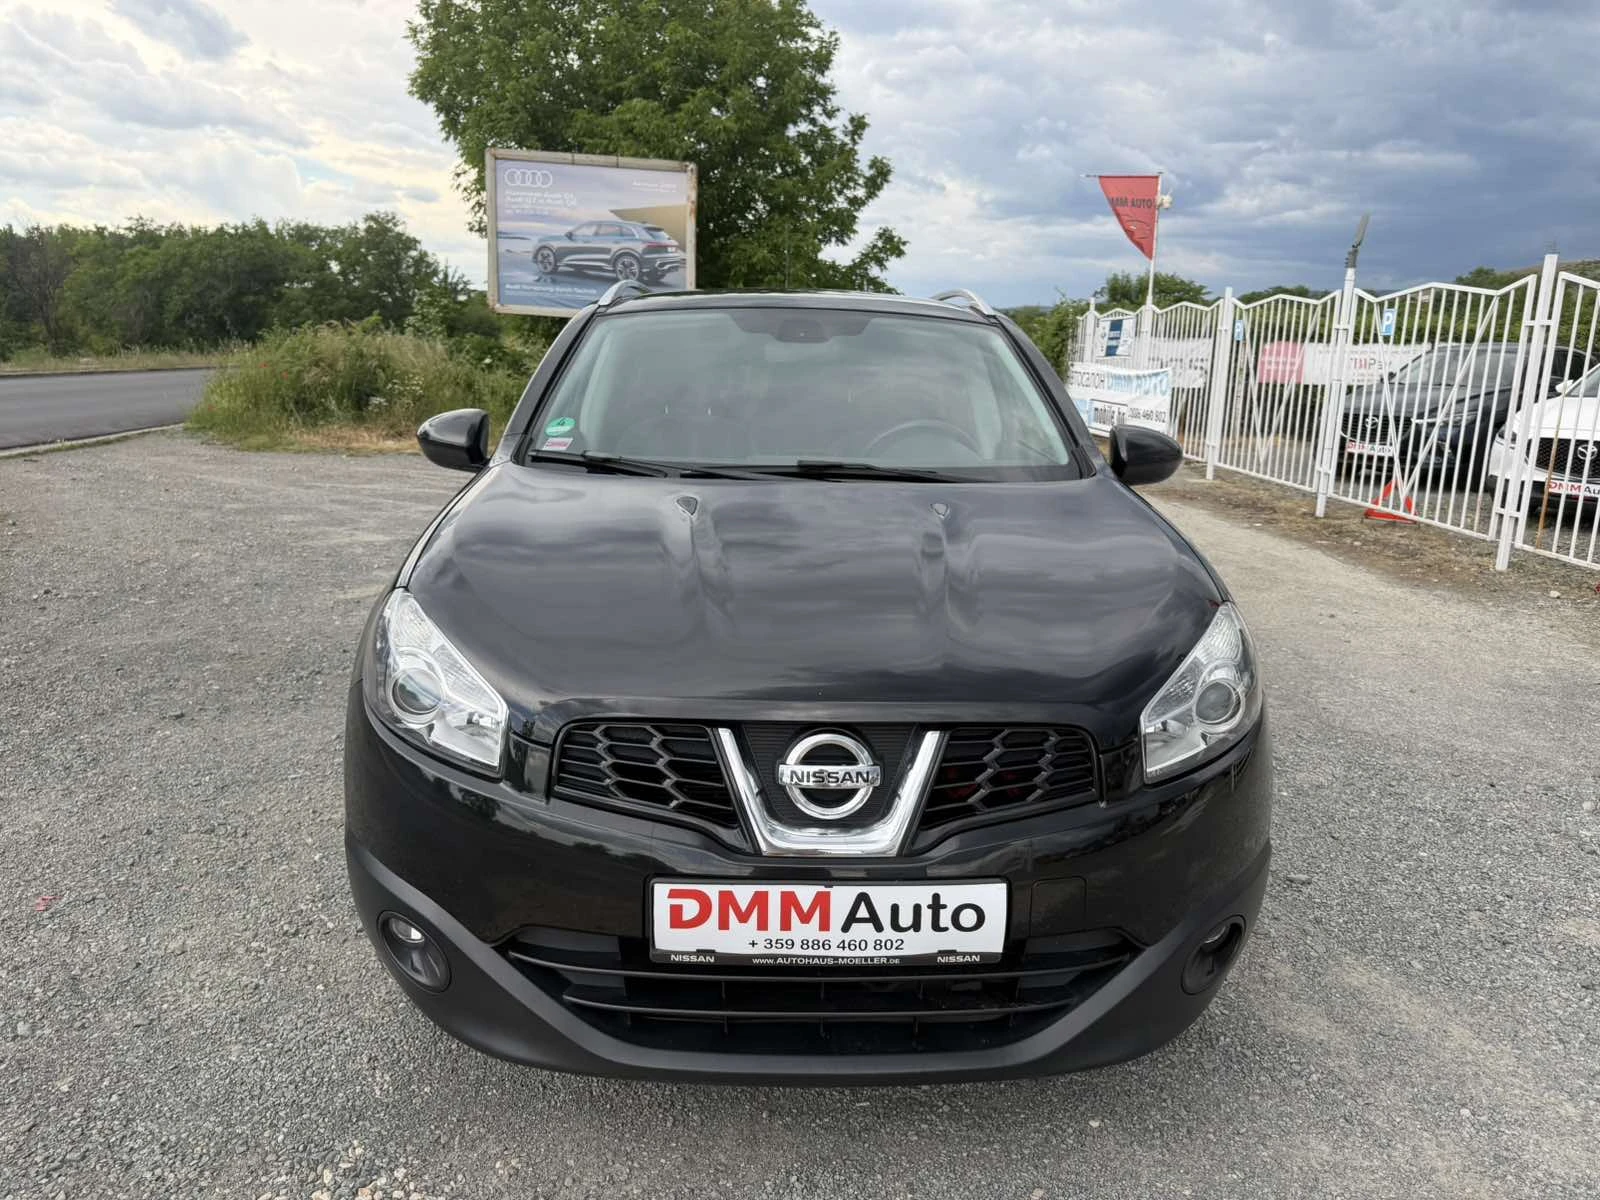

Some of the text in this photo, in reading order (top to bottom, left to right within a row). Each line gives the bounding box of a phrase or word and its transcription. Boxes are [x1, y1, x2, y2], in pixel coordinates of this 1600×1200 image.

[1383, 313, 1393, 329] P
[1549, 481, 1582, 493] DMM
[789, 769, 870, 784] NISSAN
[667, 888, 986, 934] DMM Auto
[763, 938, 795, 950] 359
[800, 938, 832, 951] 886
[836, 938, 868, 951] 460
[873, 938, 905, 951] 802
[670, 954, 715, 963] NISSAN
[936, 954, 981, 963] NISSAN
